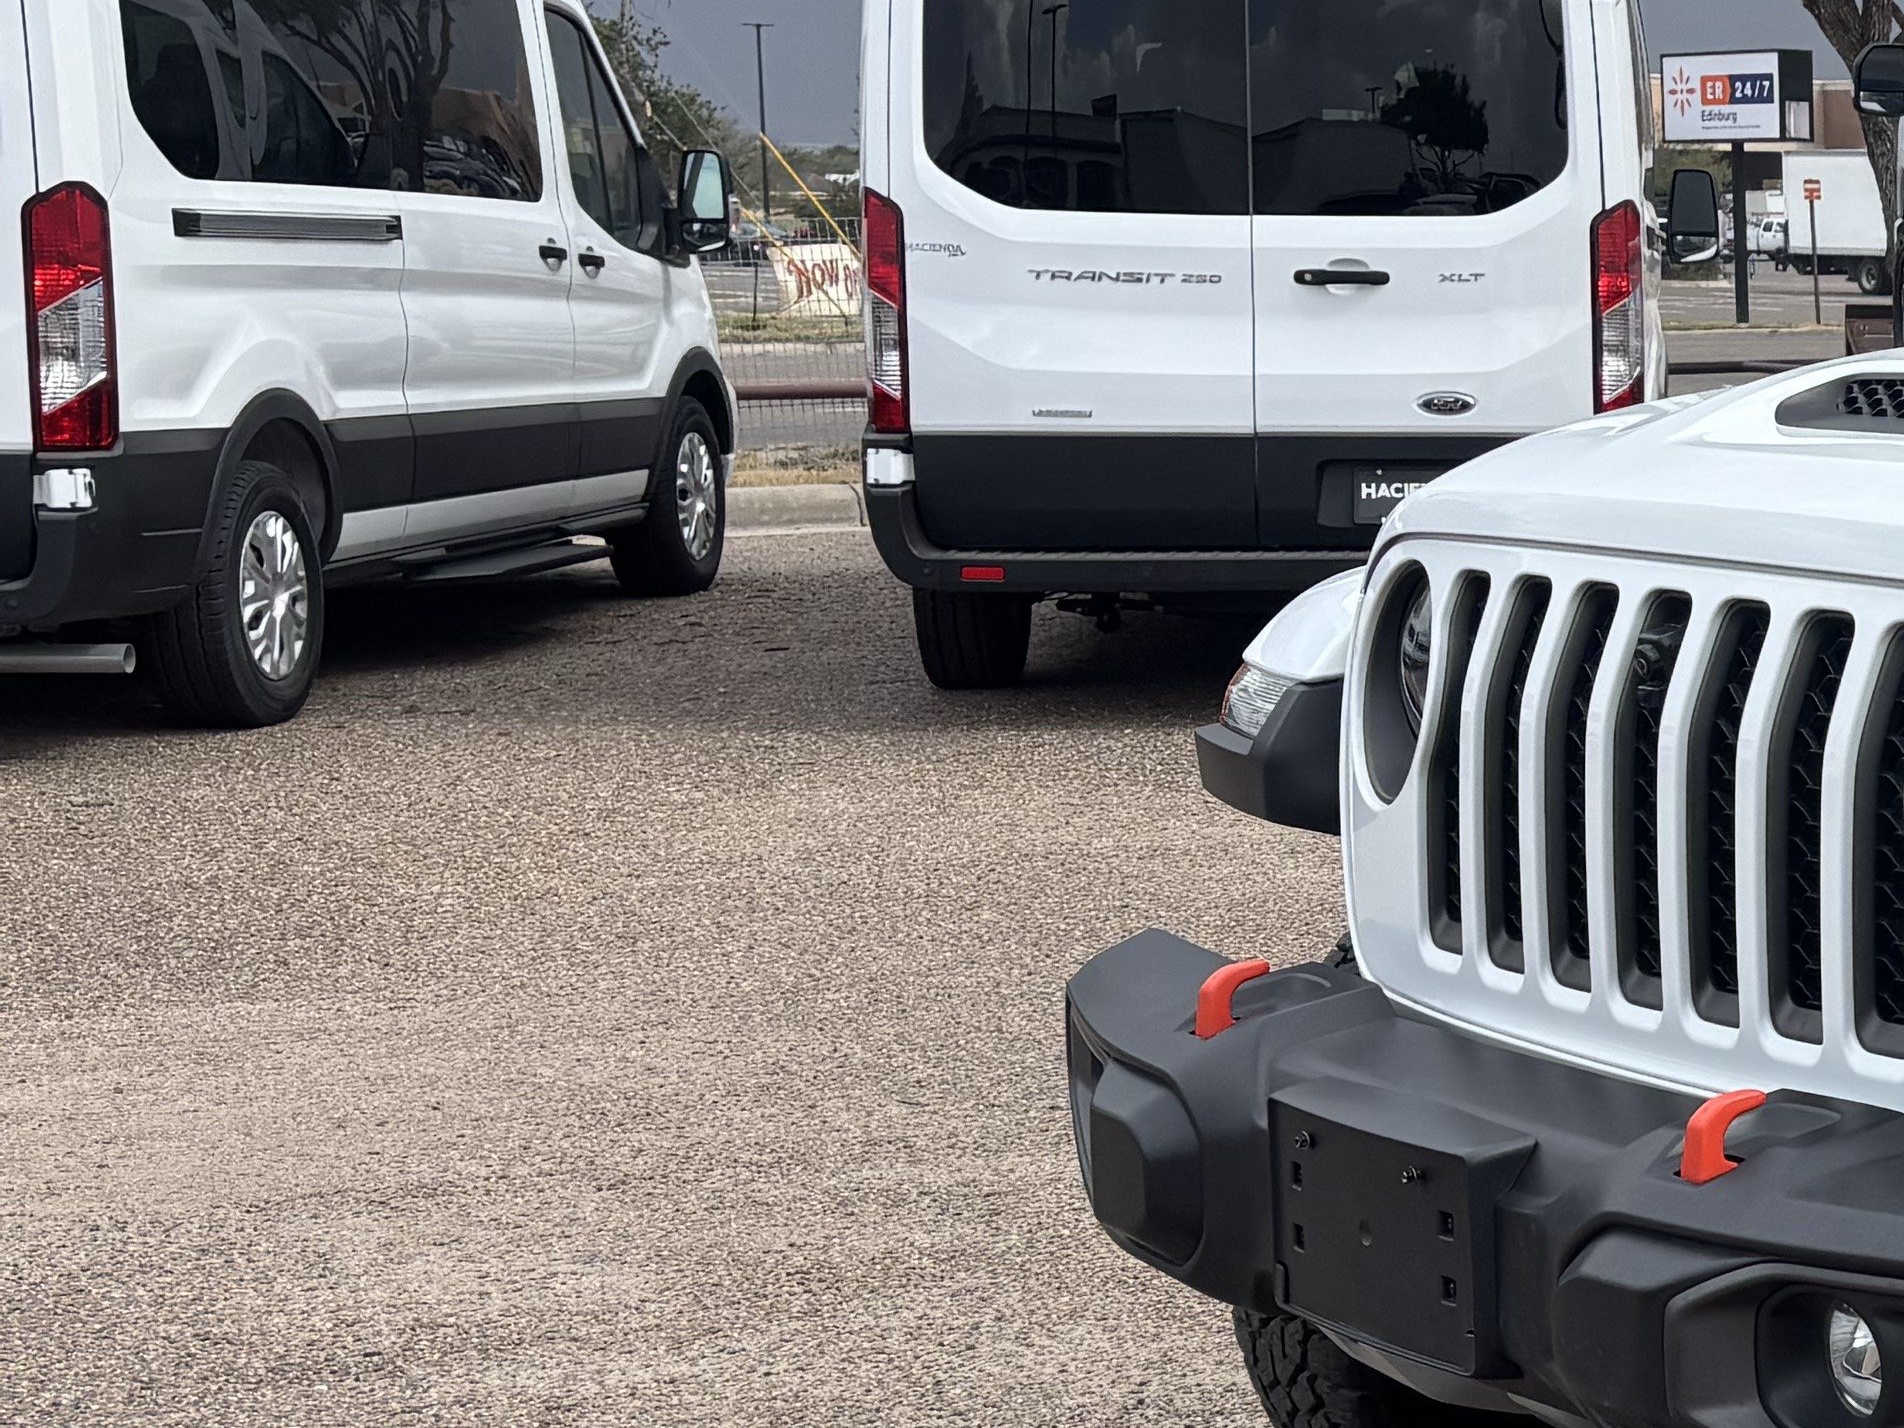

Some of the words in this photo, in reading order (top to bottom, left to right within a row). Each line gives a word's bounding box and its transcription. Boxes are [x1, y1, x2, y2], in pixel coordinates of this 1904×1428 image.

[1706, 80, 1724, 100] ER
[1734, 80, 1771, 99] 24/7
[1701, 109, 1738, 124] Edinburg
[1027, 269, 1176, 285] TRANSIT
[1437, 273, 1486, 283] XLT
[1361, 483, 1427, 500] HACIE
